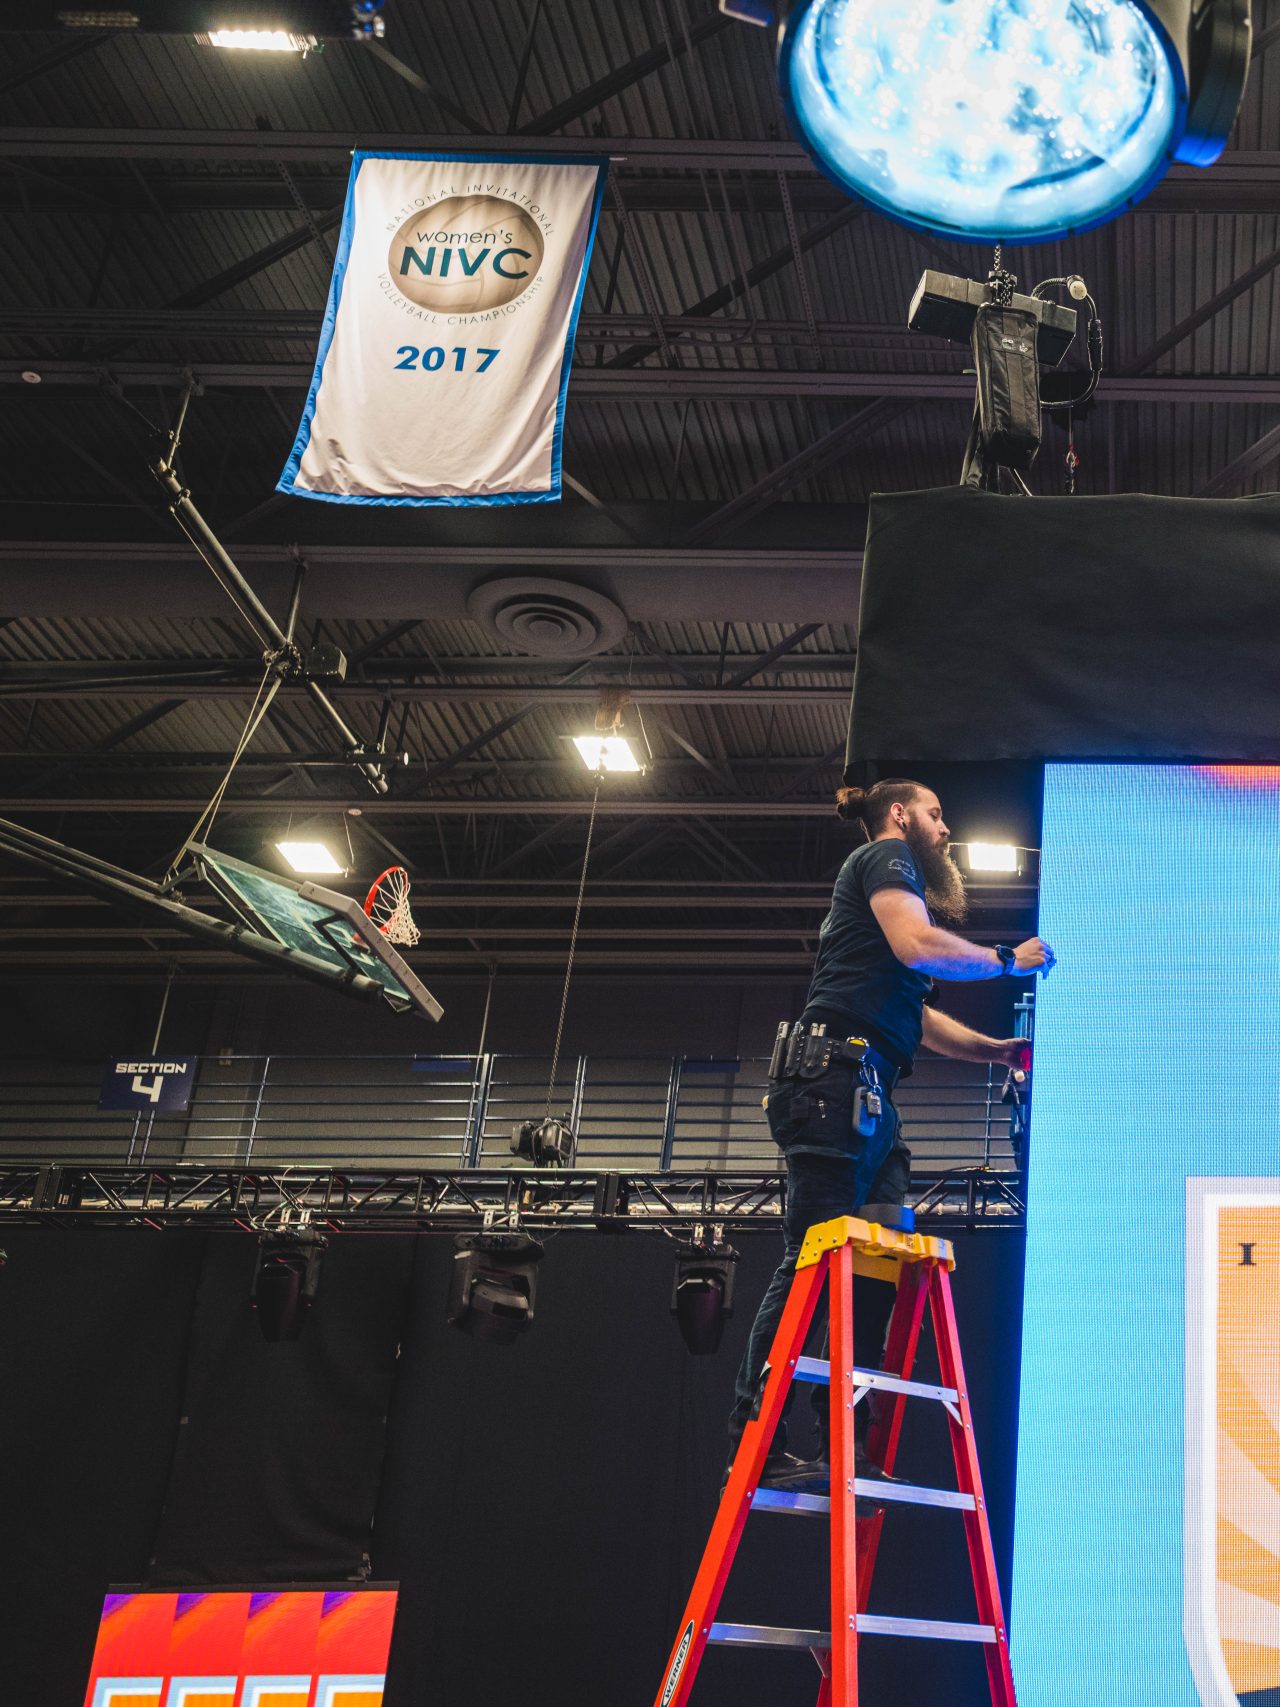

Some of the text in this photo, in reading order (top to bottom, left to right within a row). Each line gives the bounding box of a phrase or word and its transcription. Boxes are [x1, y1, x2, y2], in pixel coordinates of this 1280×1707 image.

[386, 184, 555, 237] NATIONAL INVITATIONAL
[416, 230, 513, 244] women's
[399, 246, 533, 280] NIVC
[377, 272, 545, 325] VOLLEYBALL CHAMPIONSHIP
[394, 345, 501, 373] 2017
[115, 1062, 187, 1073] SECTION
[131, 1075, 164, 1103] 4
[665, 1640, 688, 1698] WERNER
